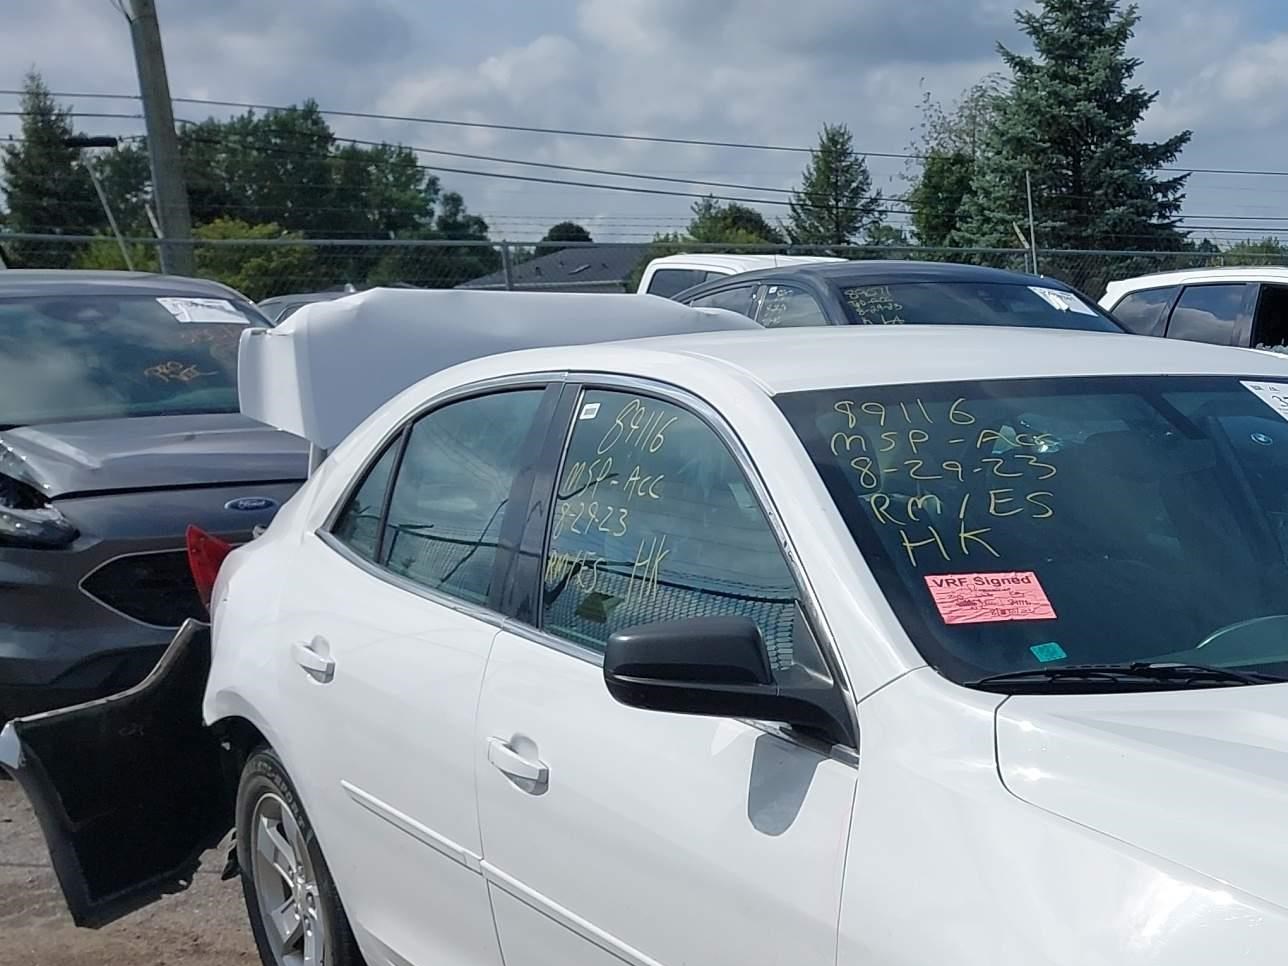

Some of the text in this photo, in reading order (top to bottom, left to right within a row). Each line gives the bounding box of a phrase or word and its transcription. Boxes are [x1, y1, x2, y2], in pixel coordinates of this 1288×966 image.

[597, 398, 678, 455] 89116
[834, 398, 976, 429] 89116
[850, 454, 1057, 489] 8-29-23
[899, 521, 1000, 567] HK
[626, 534, 671, 604] HK
[932, 575, 1031, 588] VRF Signed
